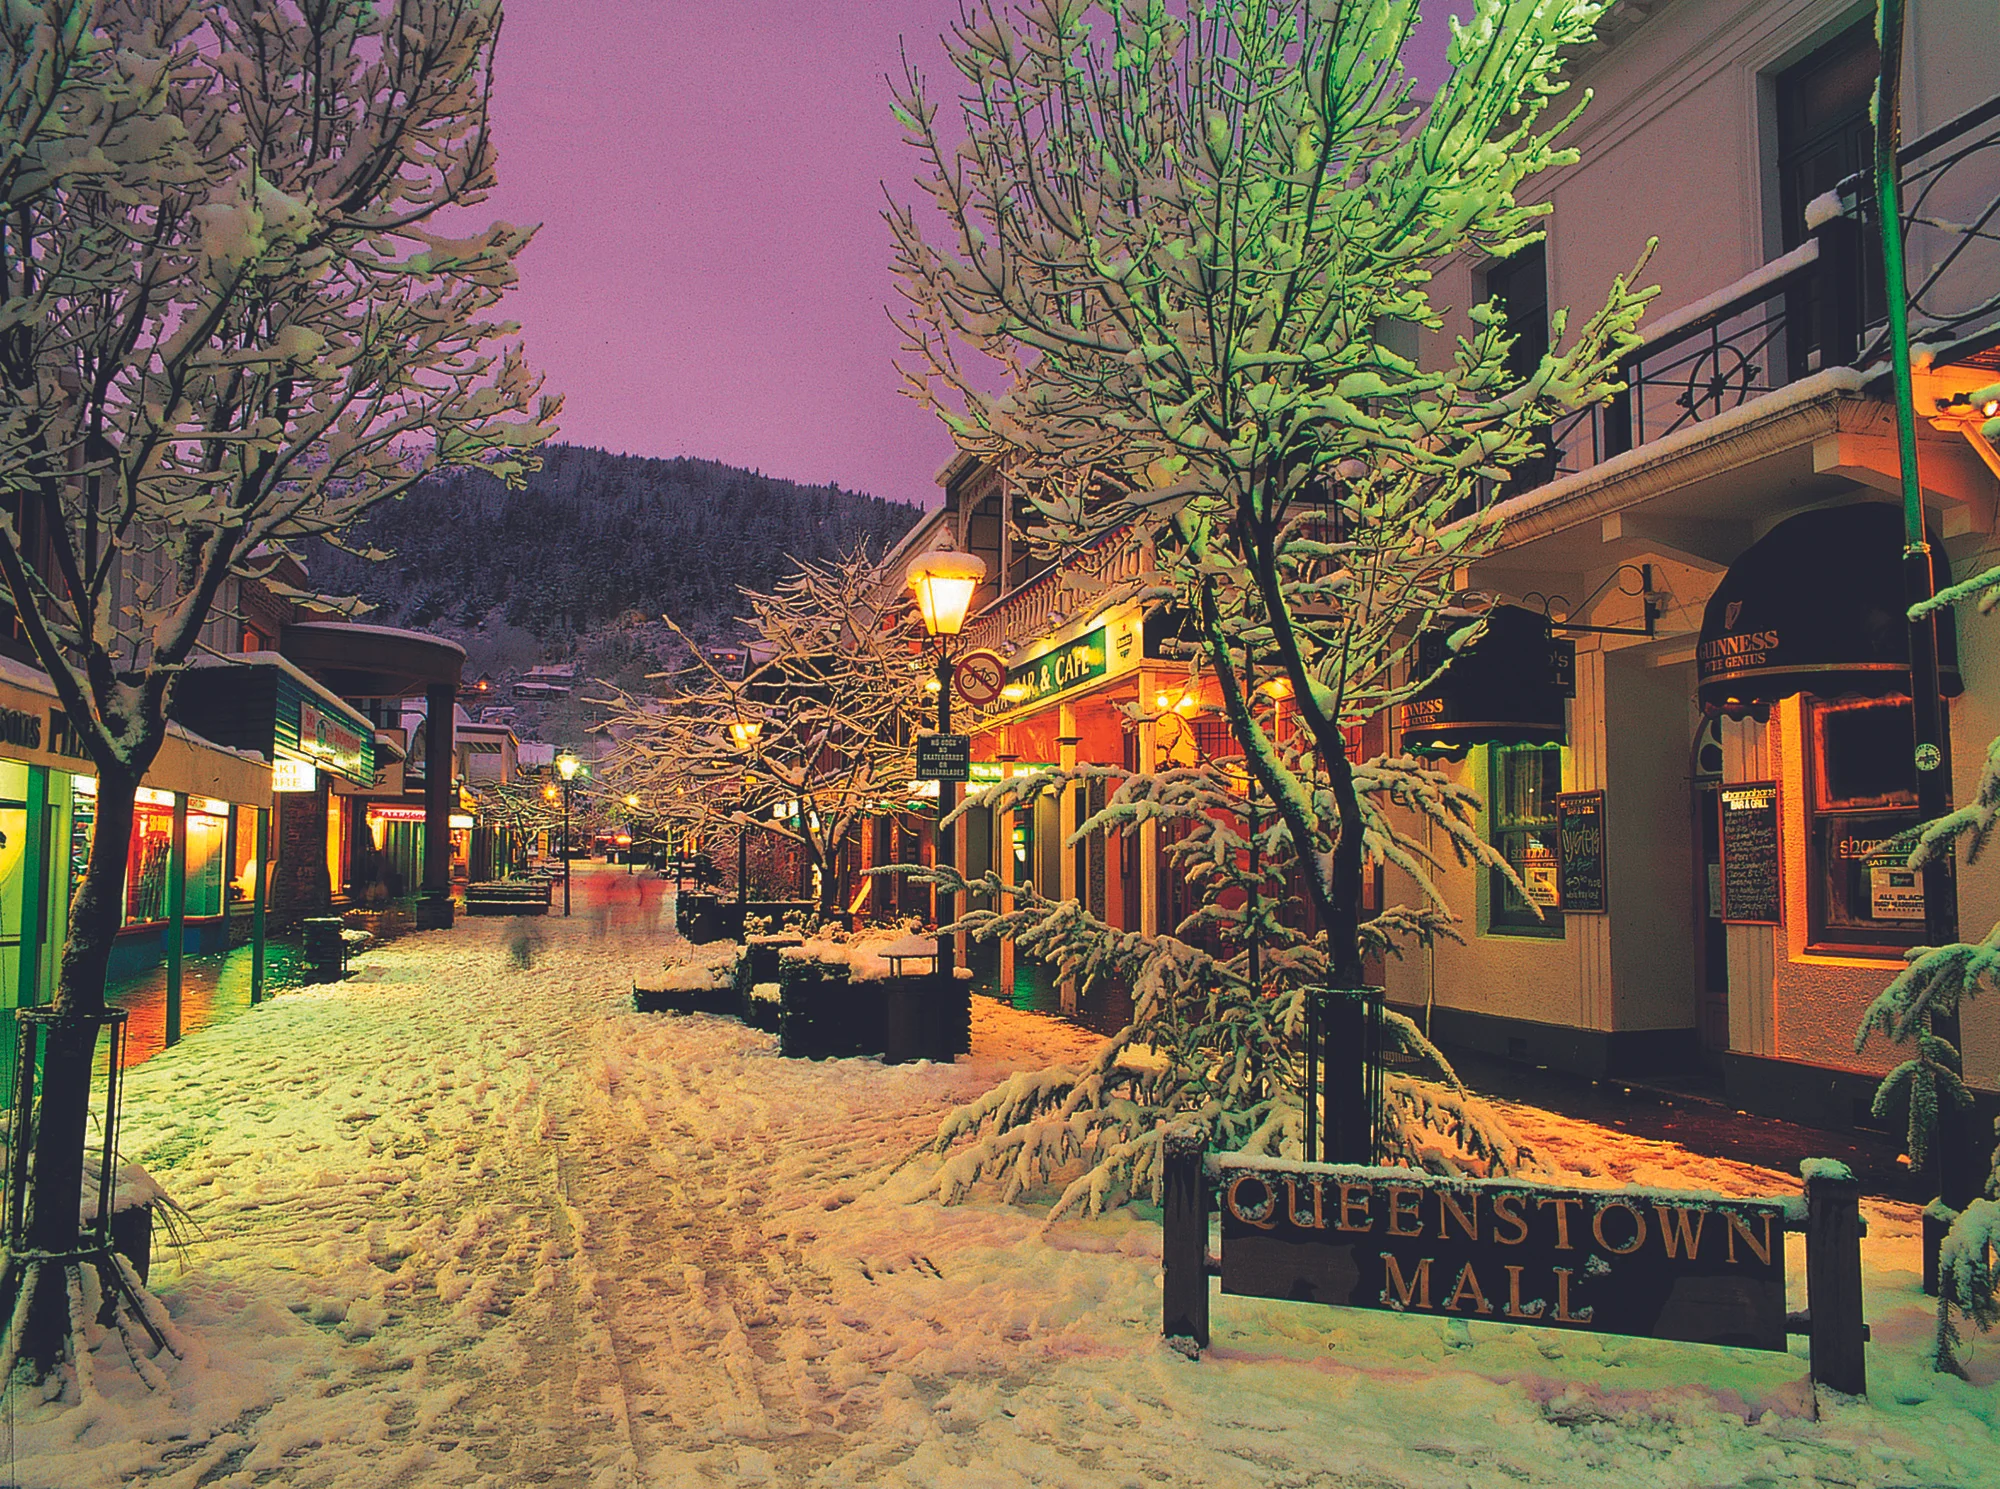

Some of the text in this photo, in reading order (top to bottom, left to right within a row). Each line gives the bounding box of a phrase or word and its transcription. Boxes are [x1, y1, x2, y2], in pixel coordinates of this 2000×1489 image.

[1700, 630, 1779, 660] GUINNESS
[1725, 652, 1766, 668] GENIUS
[923, 753, 964, 762] SKATEBOARDS
[921, 768, 965, 776] ROLLERBLADES
[1227, 1175, 1777, 1266] QUEENSTOWN
[1379, 1252, 1594, 1323] MALL
